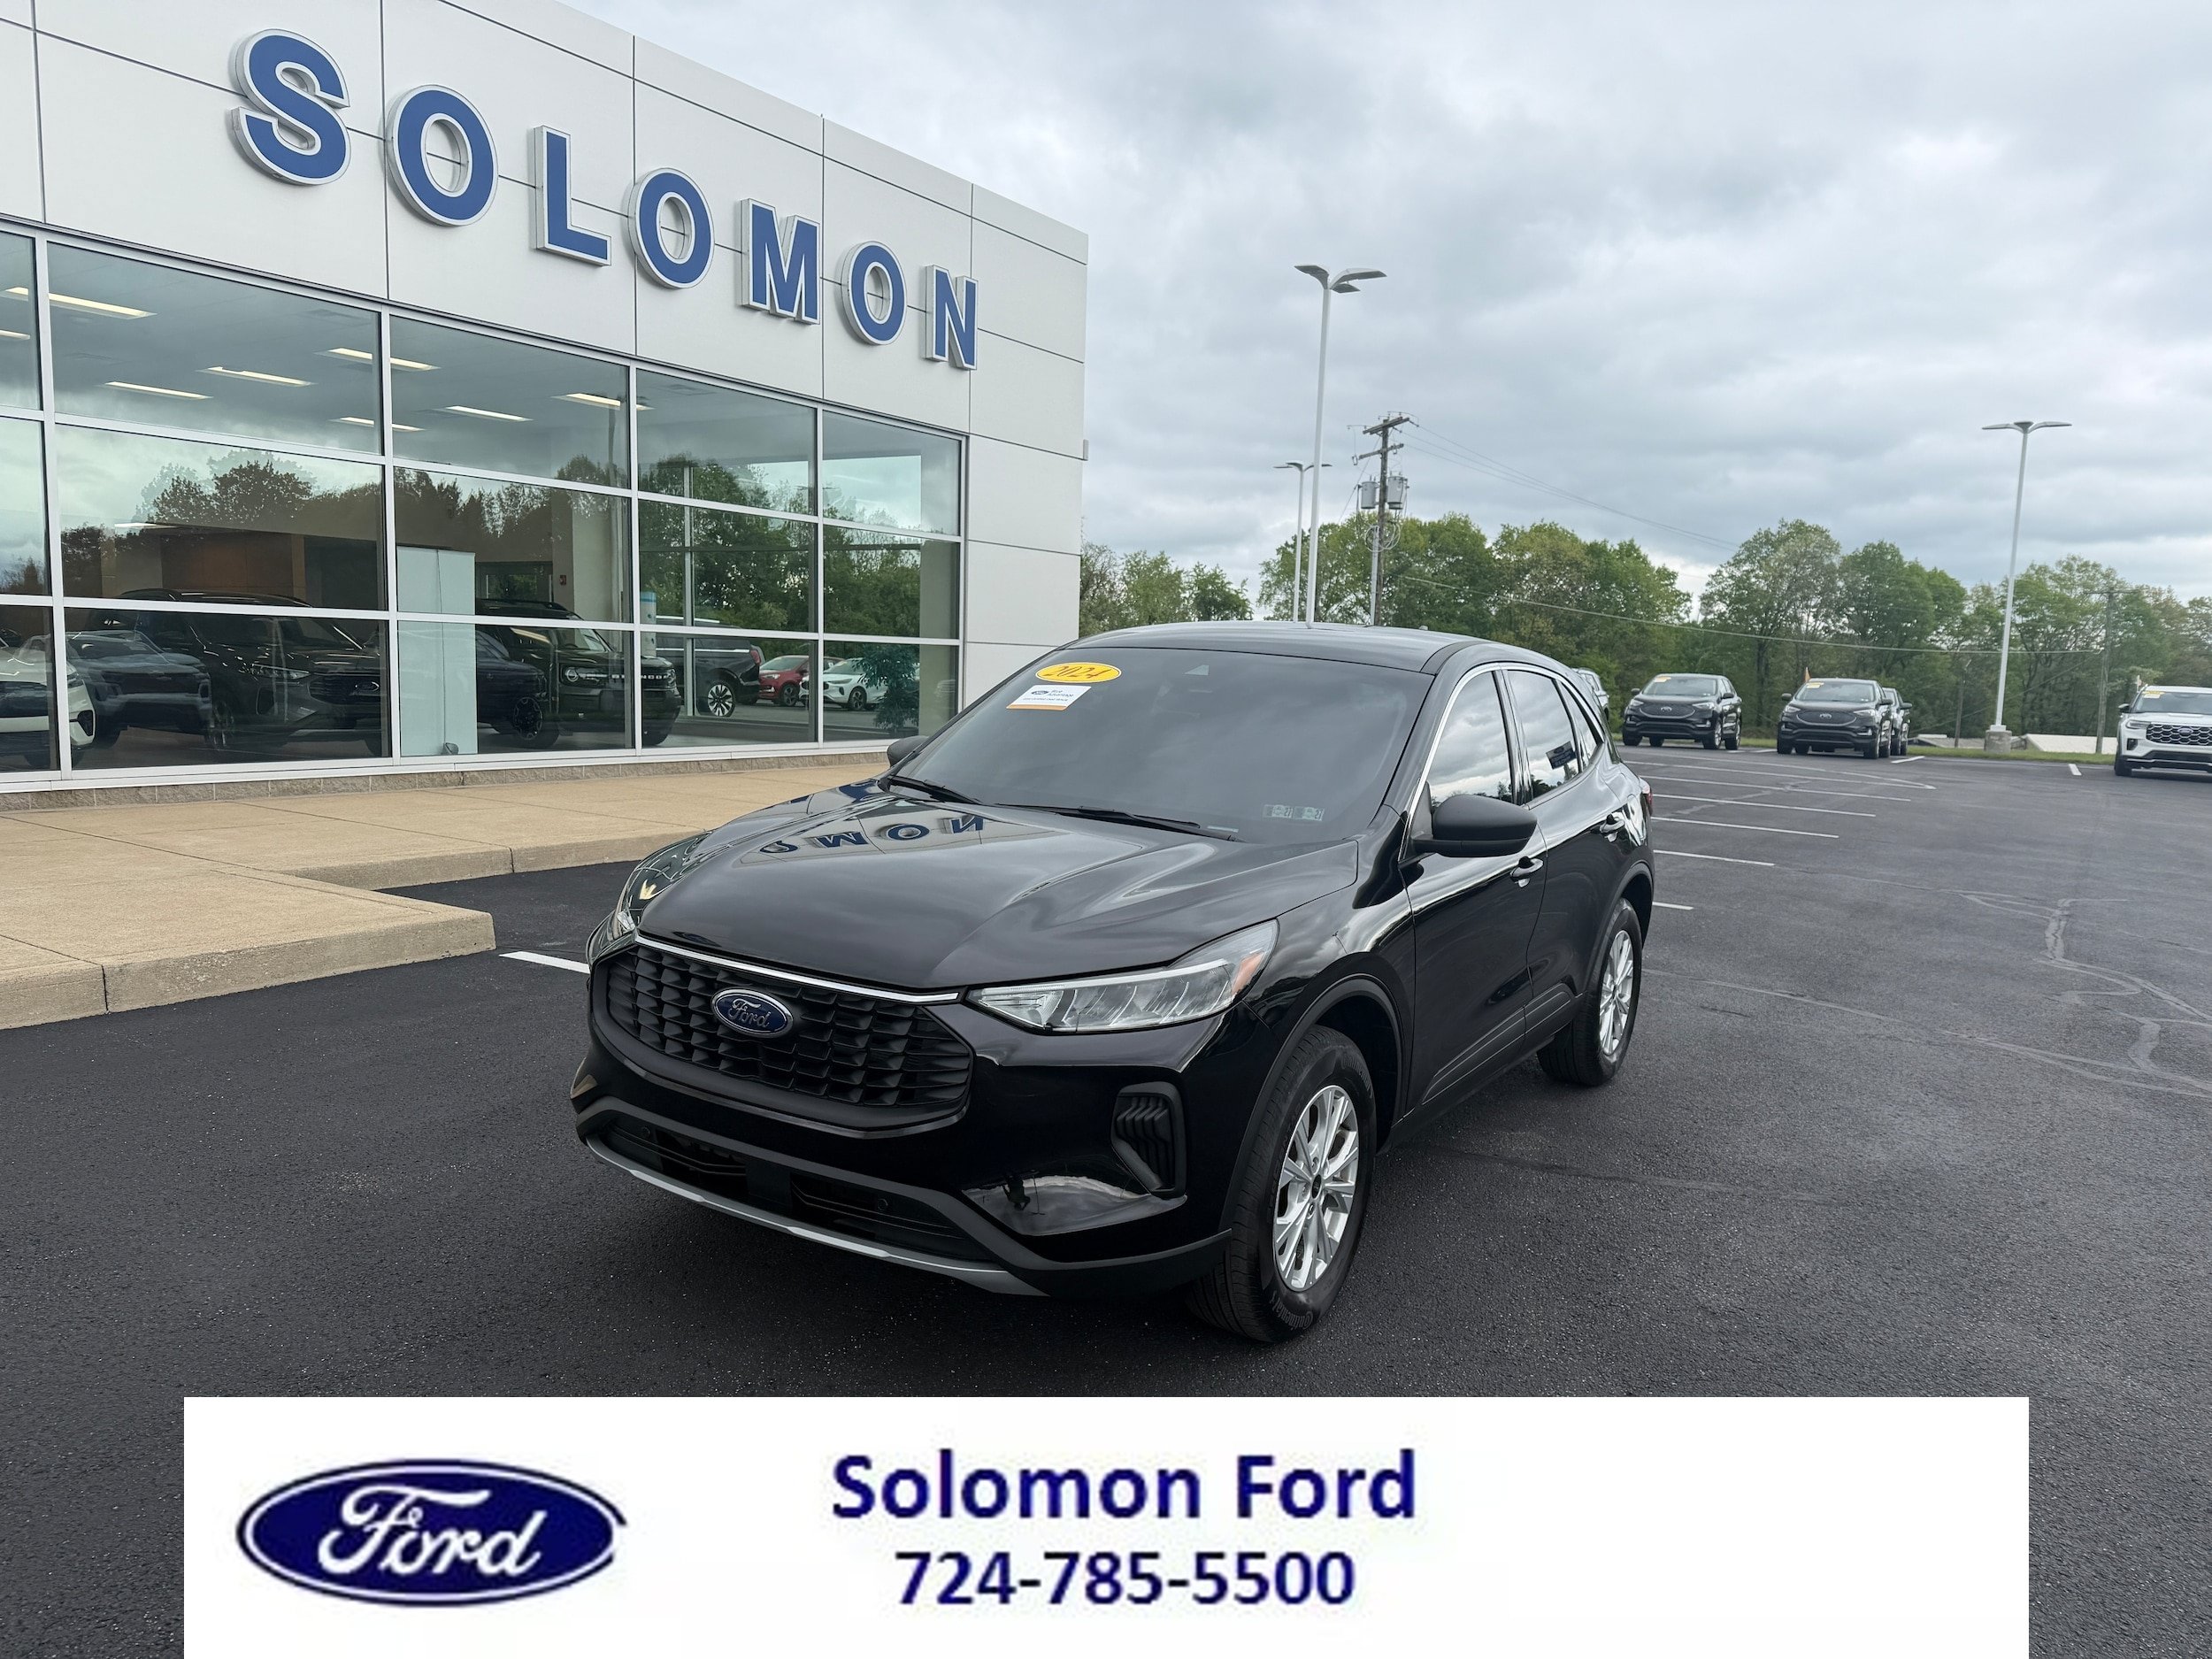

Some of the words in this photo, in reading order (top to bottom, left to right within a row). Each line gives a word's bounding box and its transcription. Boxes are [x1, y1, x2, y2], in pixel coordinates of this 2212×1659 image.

[232, 29, 979, 370] SOLOMON
[1042, 665, 1111, 680] 2024
[727, 998, 772, 1027] Ford
